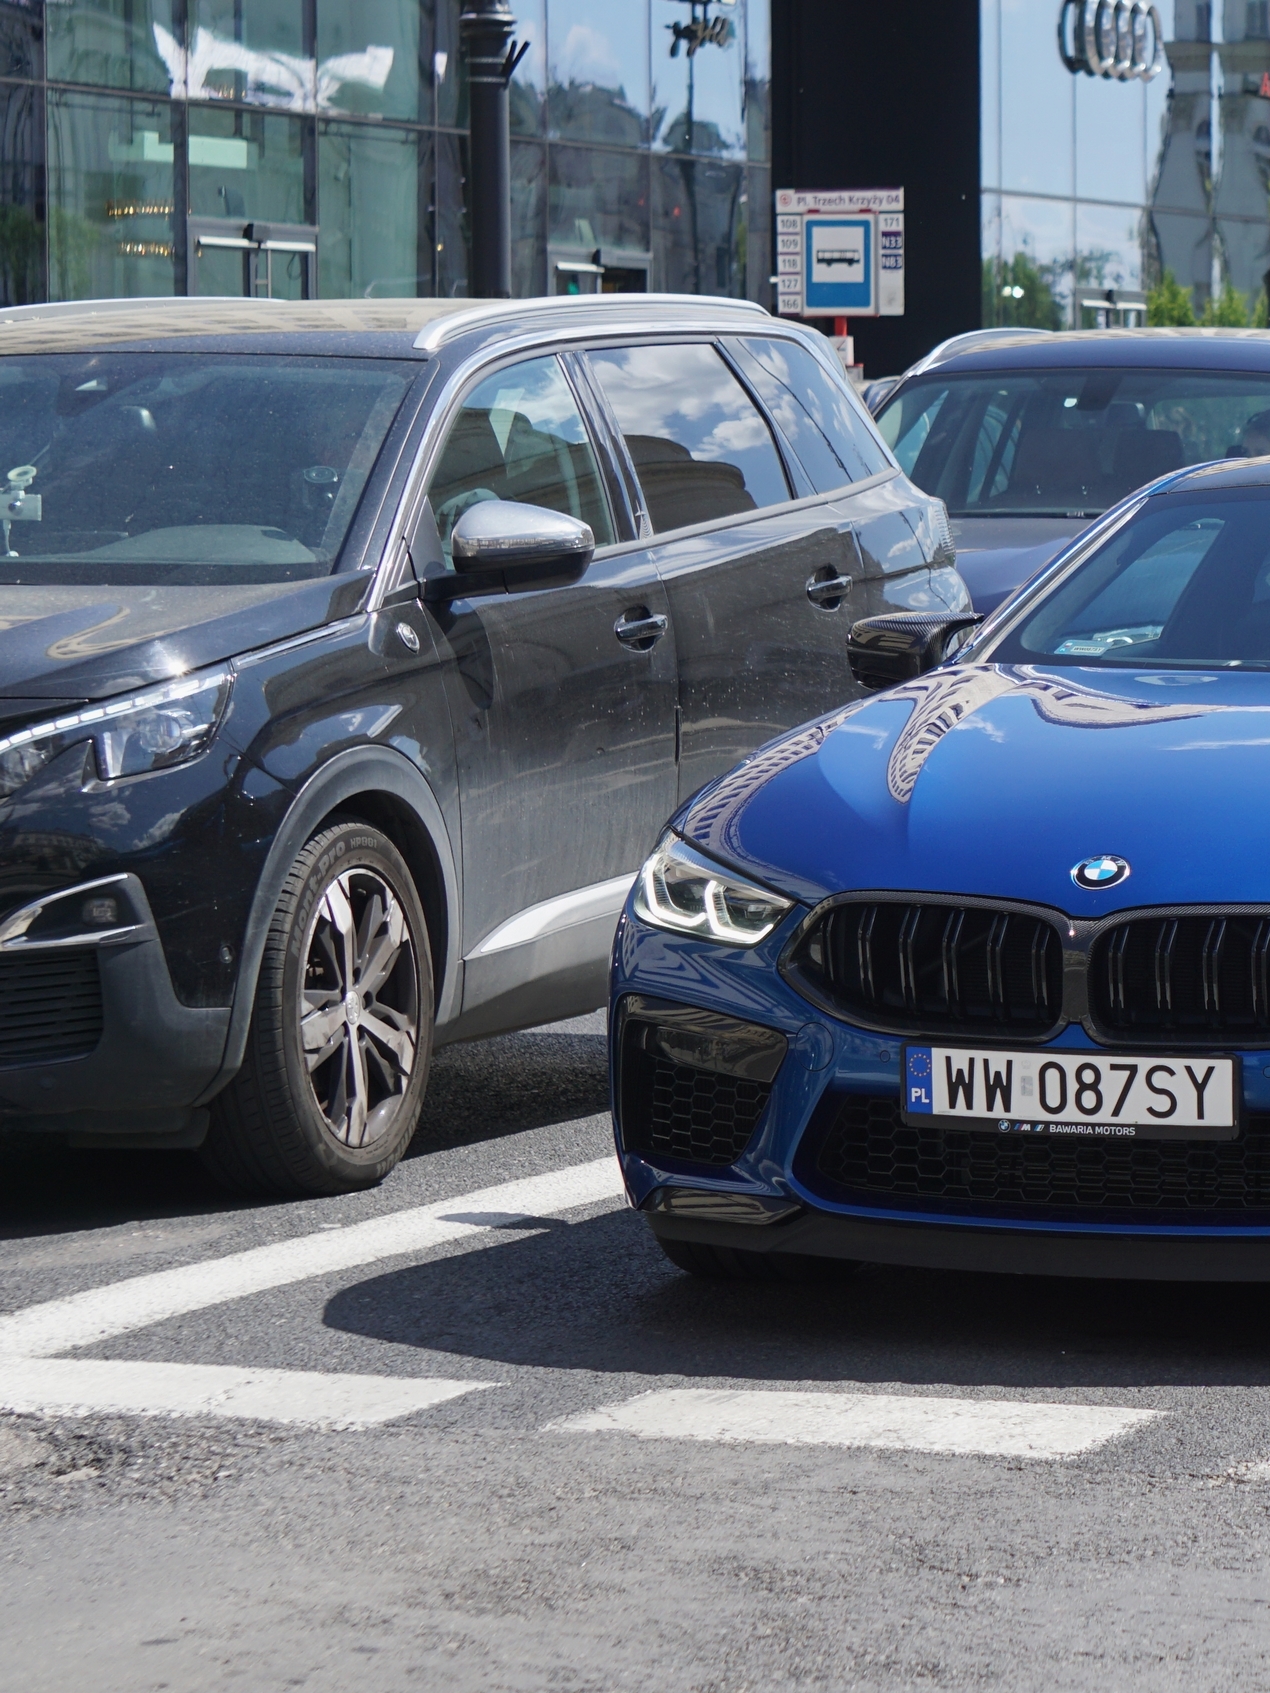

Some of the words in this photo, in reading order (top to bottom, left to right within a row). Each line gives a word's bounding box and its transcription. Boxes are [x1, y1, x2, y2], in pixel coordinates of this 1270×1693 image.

[796, 196, 810, 207] Pl.
[813, 195, 846, 206] Trzech
[848, 193, 884, 208] Krzyży
[886, 193, 900, 205] 04
[780, 218, 798, 230] 108
[883, 217, 901, 228] 171
[780, 238, 799, 250] 109
[881, 236, 902, 249] N33
[781, 258, 798, 269] 118
[781, 278, 799, 289] 127
[781, 298, 799, 310] 166
[945, 1055, 1013, 1113] WW
[1038, 1060, 1216, 1120] 087SY
[911, 1087, 930, 1104] PL
[1049, 1124, 1093, 1134] BAWARIA
[1095, 1126, 1136, 1136] MOTORS
